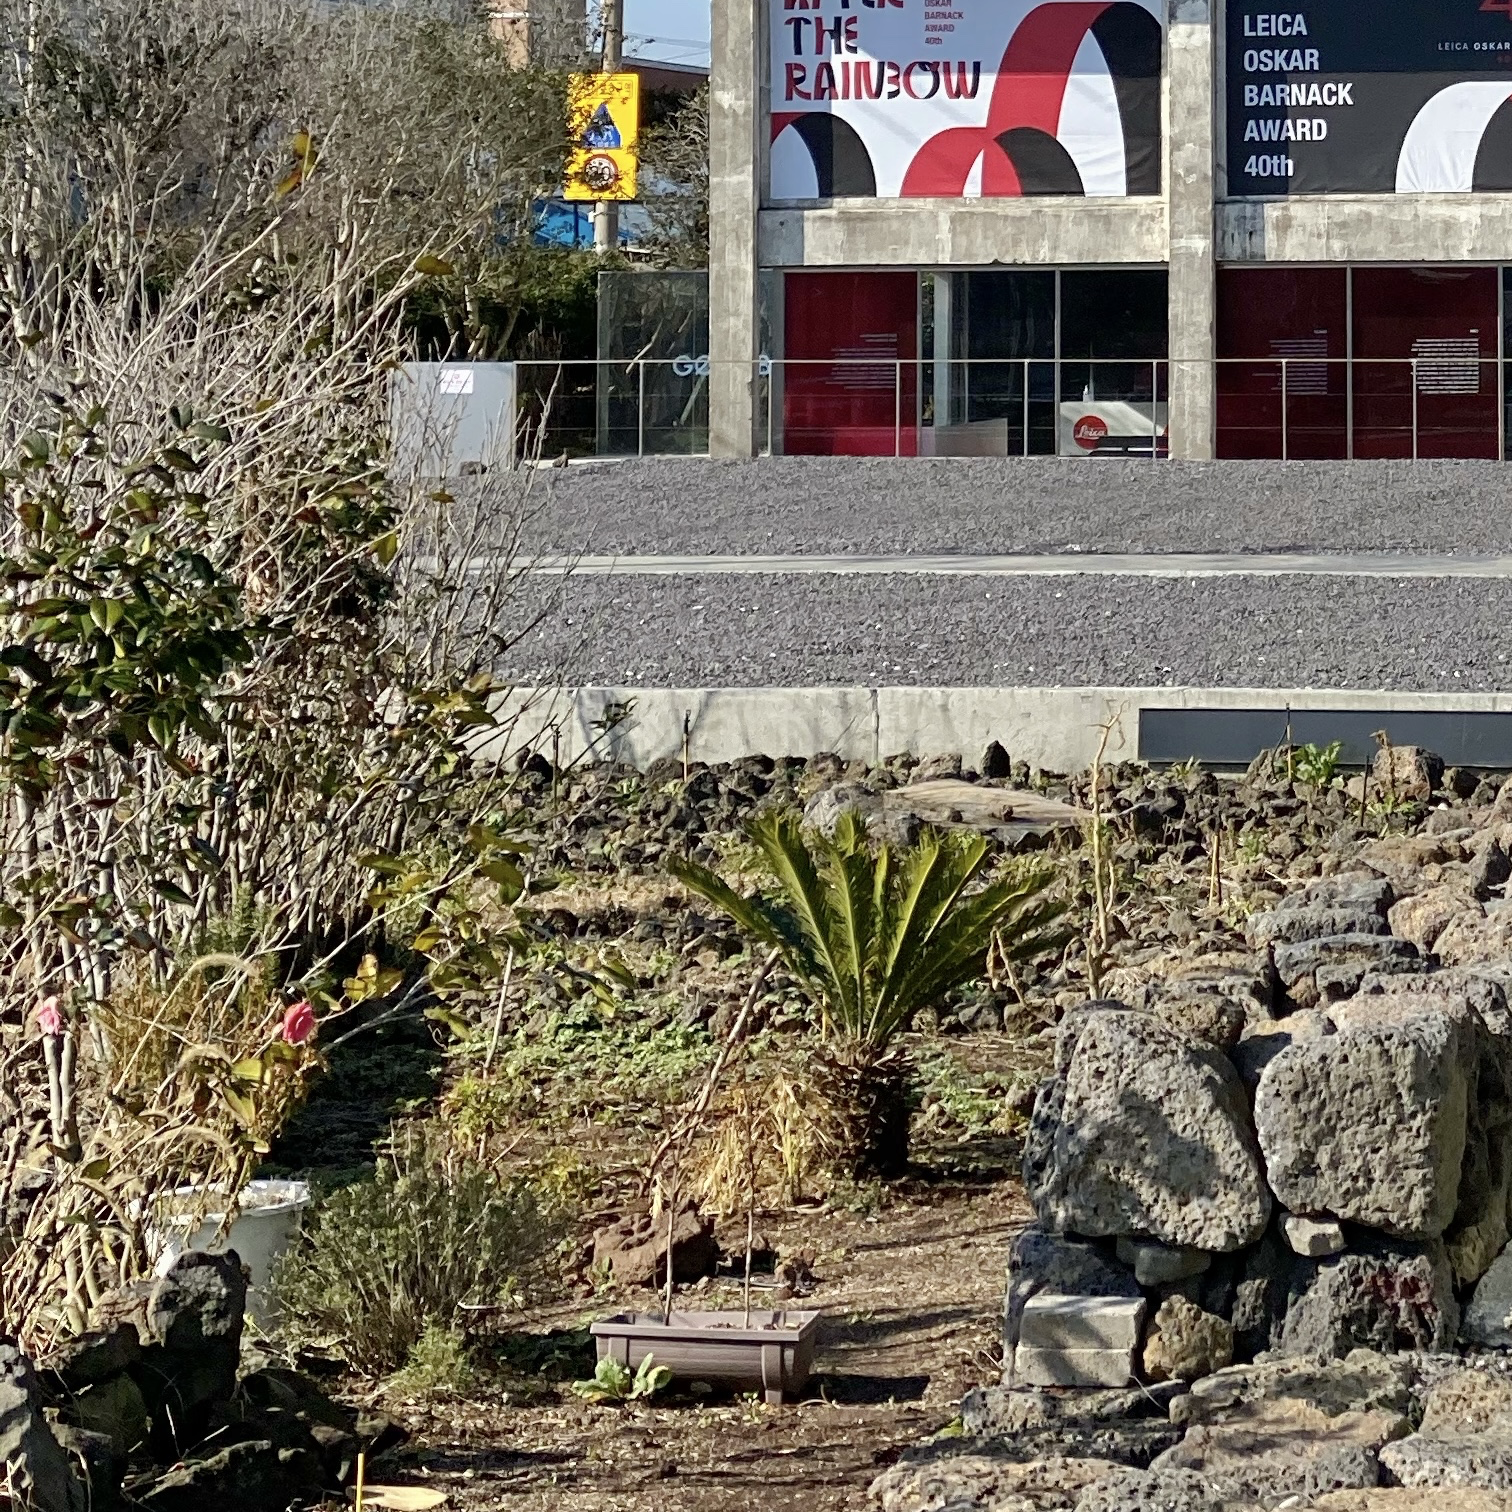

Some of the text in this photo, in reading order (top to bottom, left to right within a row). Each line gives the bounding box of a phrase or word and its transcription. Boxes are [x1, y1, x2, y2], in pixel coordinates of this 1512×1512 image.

[924, 11, 964, 20] BARNACK
[1243, 13, 1308, 36] LEICA
[783, 16, 858, 56] THE
[924, 24, 955, 32] AWARD
[1437, 42, 1469, 51] LEICA
[1473, 42, 1511, 50] OSKAR
[1243, 48, 1320, 72] OSKAR
[784, 61, 983, 102] RAINBOW
[1244, 83, 1354, 106] BARNACK
[1243, 119, 1328, 142] AWARD
[1243, 155, 1294, 177] 40th
[1074, 424, 1106, 440] Leica
